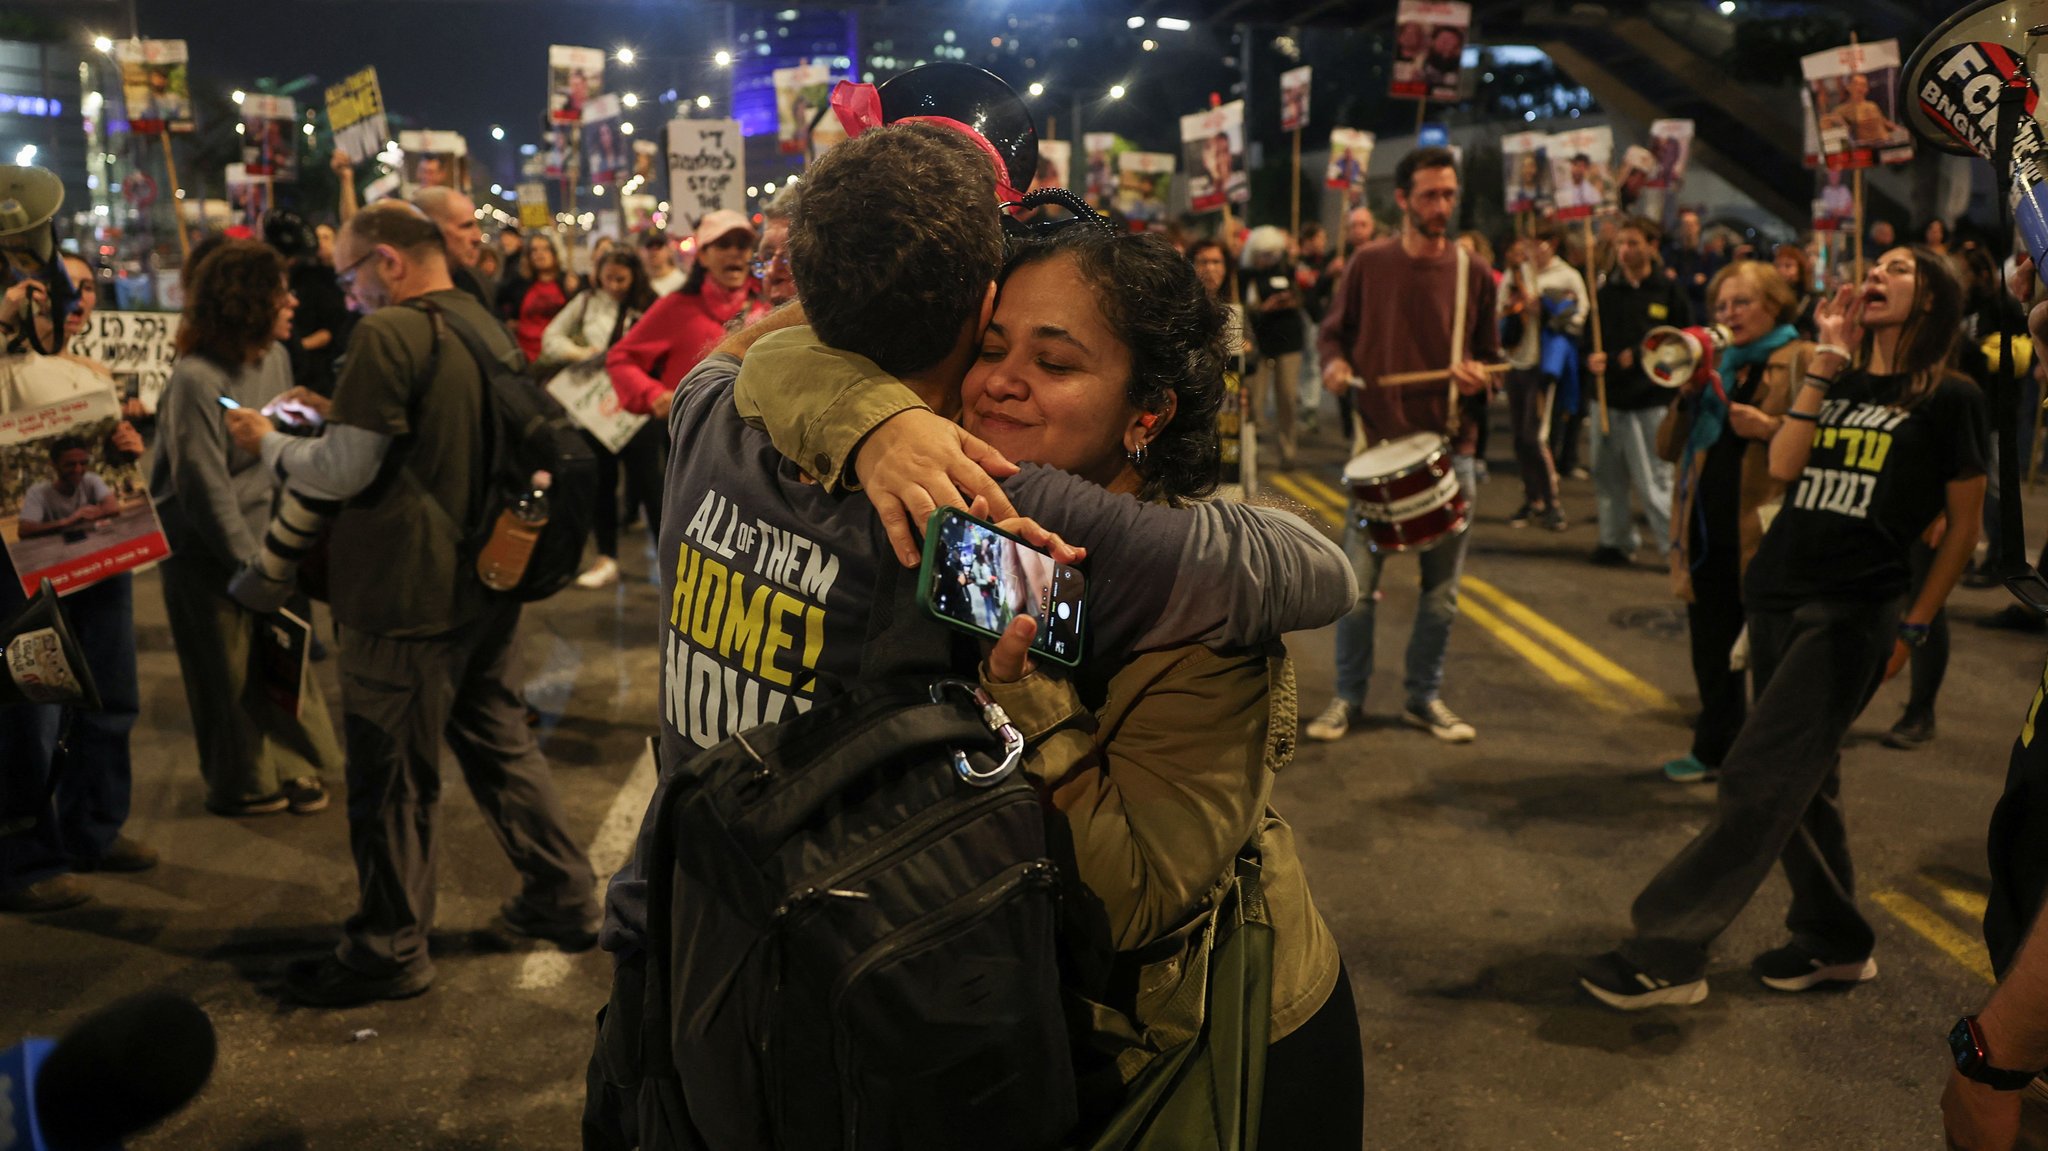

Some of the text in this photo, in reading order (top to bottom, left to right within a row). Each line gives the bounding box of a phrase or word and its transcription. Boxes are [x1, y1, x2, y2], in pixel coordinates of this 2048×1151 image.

[687, 174, 731, 191] STOP
[1793, 466, 1877, 519] בעזה
[684, 489, 839, 604] ALL OF THEM
[670, 541, 826, 693] HOME!
